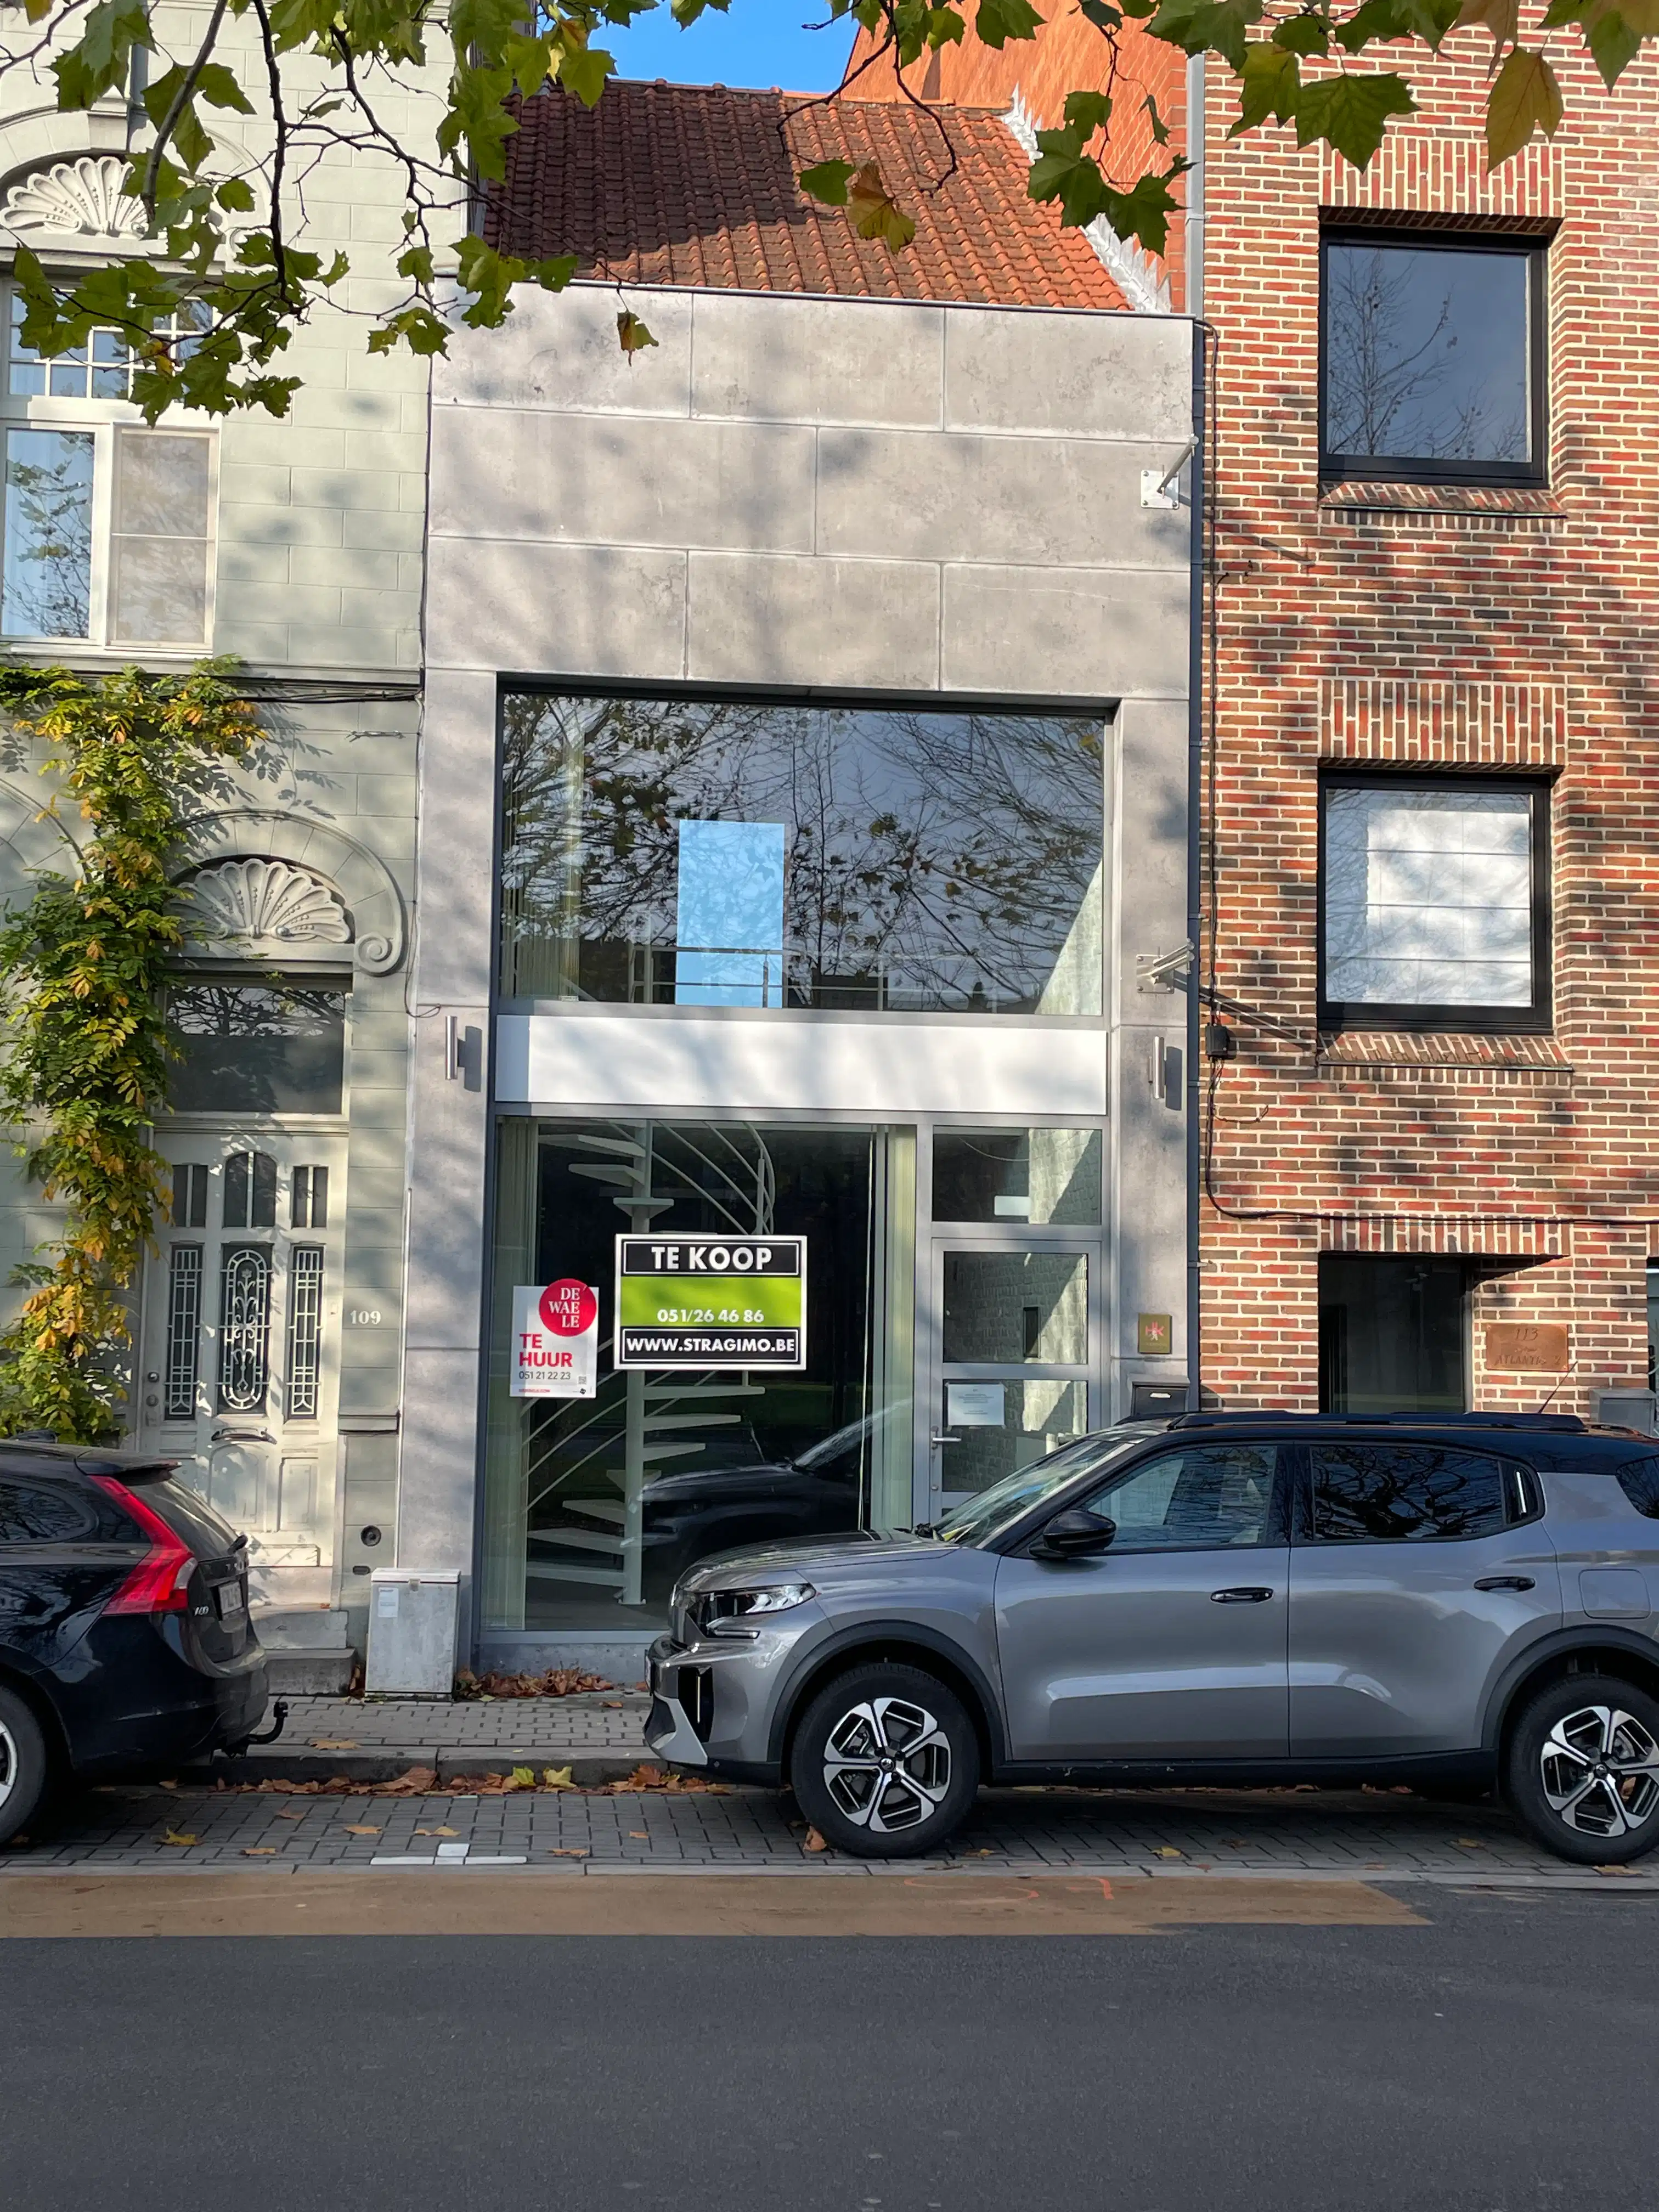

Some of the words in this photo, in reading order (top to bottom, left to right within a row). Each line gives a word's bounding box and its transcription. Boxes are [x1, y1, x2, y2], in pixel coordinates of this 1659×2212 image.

[651, 1246, 680, 1269] TE
[689, 1246, 772, 1270] KOOP
[560, 1288, 580, 1300] DE
[549, 1301, 580, 1314] WAE
[349, 1310, 381, 1325] 109
[561, 1315, 580, 1328] LE
[657, 1309, 715, 1323] 051/26
[718, 1310, 740, 1323] 46
[743, 1310, 765, 1323] 86
[519, 1334, 542, 1348] TE
[1514, 1328, 1538, 1341] 113
[626, 1338, 795, 1352] WWW.STRAGIMO.BE
[519, 1352, 573, 1368] HUUR
[548, 1372, 558, 1380] 22
